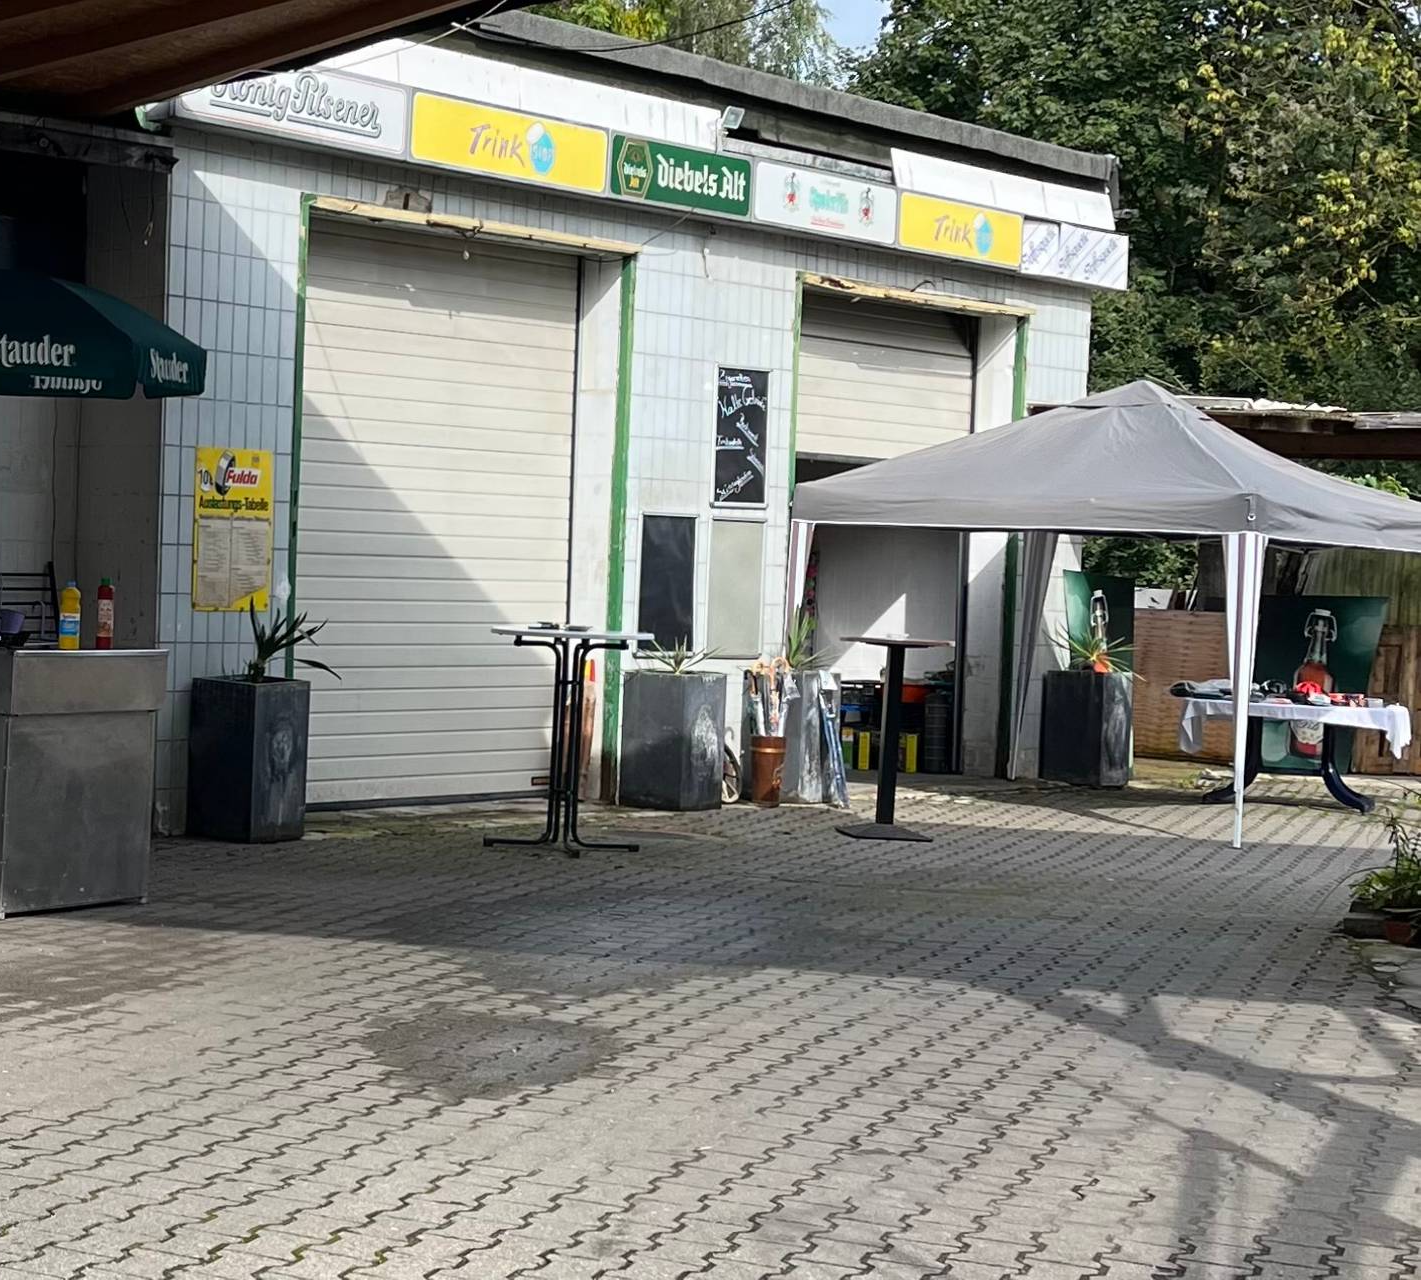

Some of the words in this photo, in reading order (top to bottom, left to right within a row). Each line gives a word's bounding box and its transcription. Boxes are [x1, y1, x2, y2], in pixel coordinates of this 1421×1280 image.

[470, 124, 525, 168] Trink
[657, 153, 719, 197] Diebels
[719, 166, 746, 201] Alt
[150, 348, 189, 384] Stauder
[226, 470, 258, 485] Fulda
